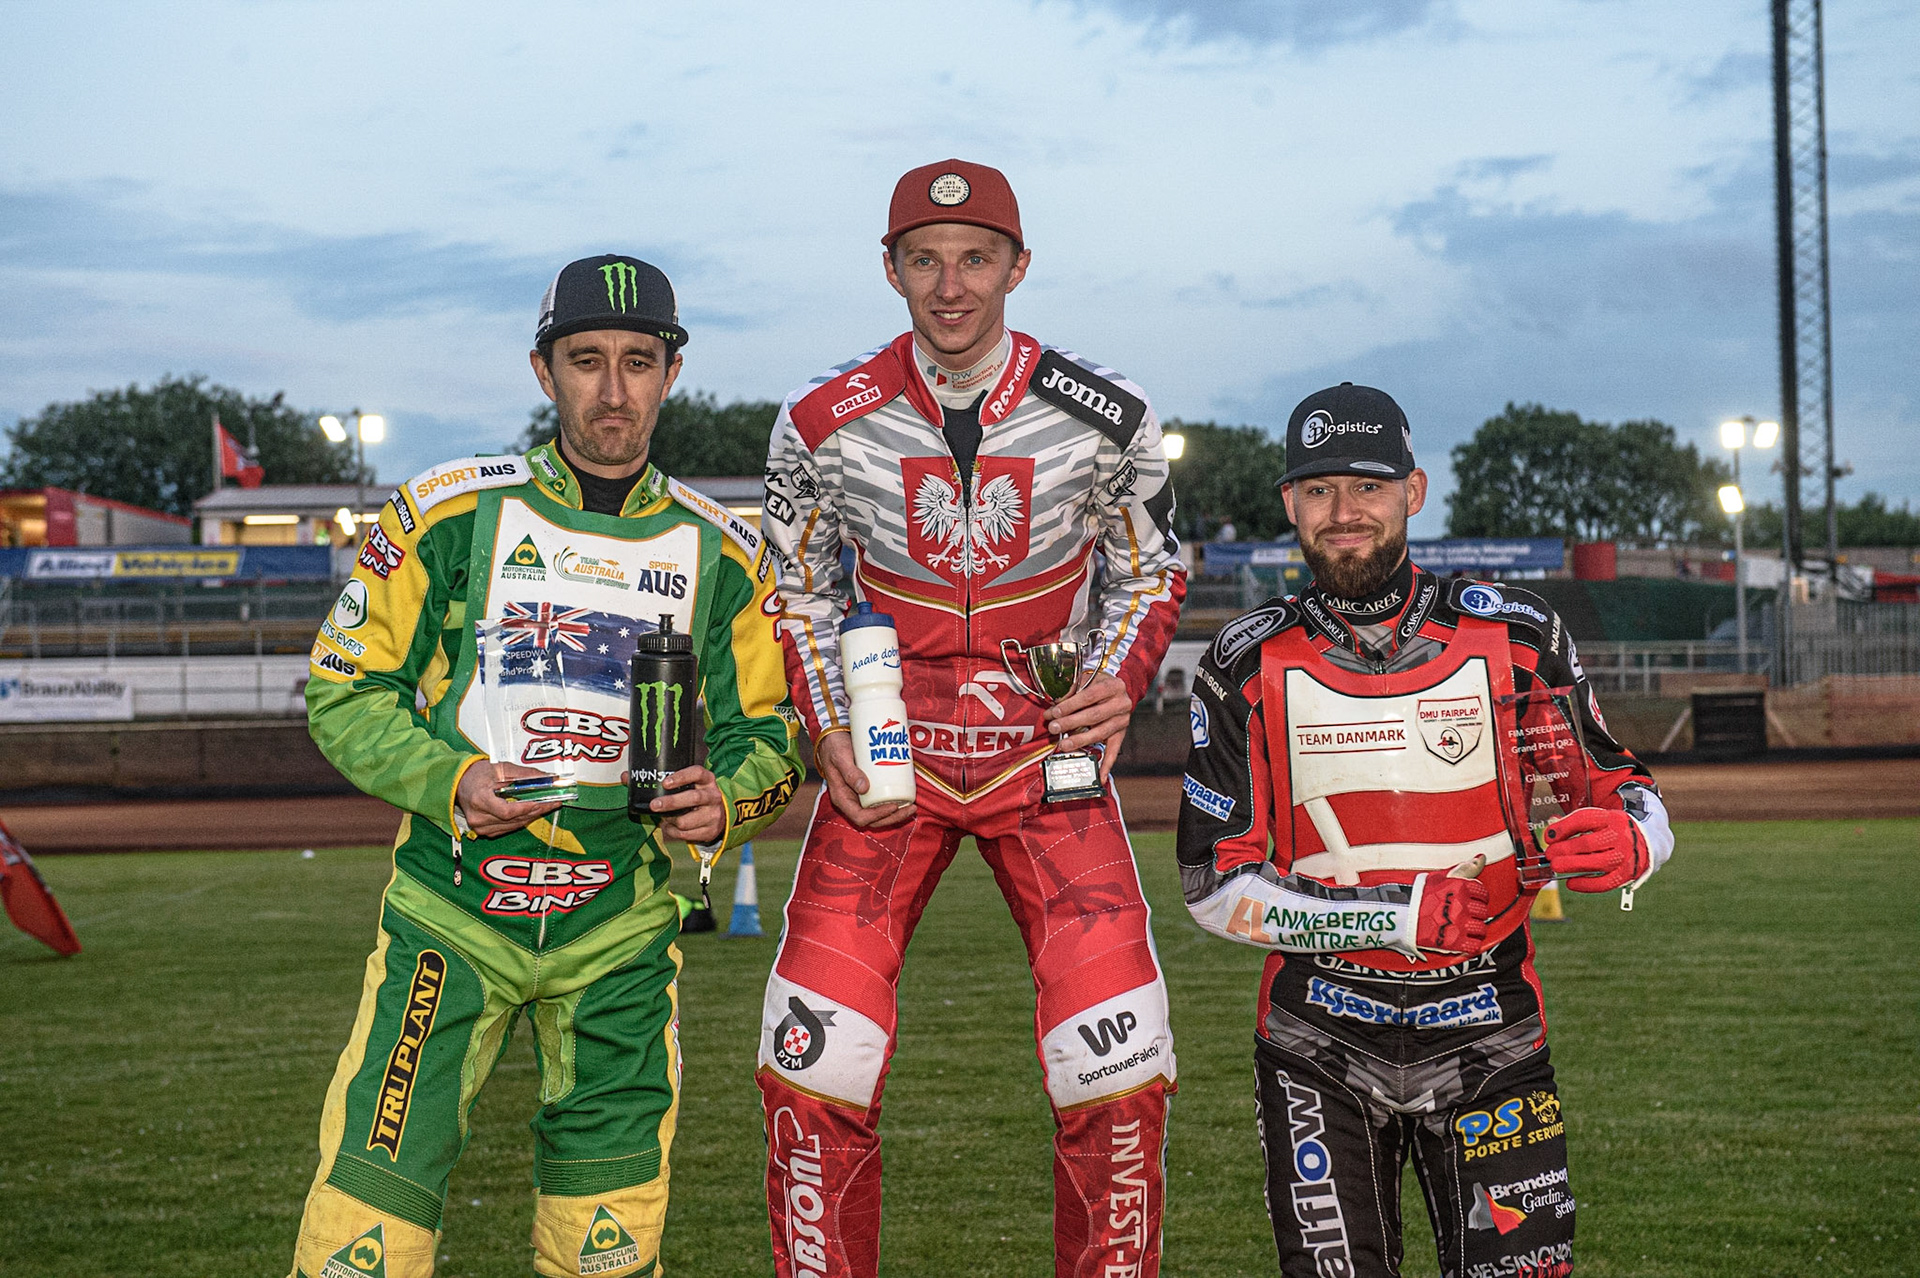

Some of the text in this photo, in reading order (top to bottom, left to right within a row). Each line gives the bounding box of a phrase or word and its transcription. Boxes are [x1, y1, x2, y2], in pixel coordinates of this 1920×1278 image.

[951, 370, 972, 380] DW
[835, 389, 879, 414] ORLEN
[1324, 420, 1379, 435] logistics
[502, 566, 546, 575] MOTORCYCLING
[580, 556, 600, 566] TEAM
[648, 560, 679, 572] SPORT
[501, 572, 546, 582] AUSTRALIA
[573, 563, 625, 580] AUSTRALIA
[637, 568, 688, 600] AUS
[340, 592, 360, 616] ATPI
[1490, 601, 1548, 623] logistics
[1222, 614, 1272, 653] GANTECH
[1420, 707, 1479, 719] DMU FAIRPLAY
[525, 710, 630, 744] CBS
[1297, 728, 1406, 746] TEAM DANMARK
[1508, 722, 1573, 738] FIM SPEEDWAY
[909, 724, 1025, 753] ORLEN
[1511, 738, 1574, 754] Grand Prix QR2
[526, 738, 621, 760] BINS
[870, 747, 910, 761] MAK
[1525, 771, 1570, 783] Glasgow
[485, 859, 610, 885] CBS
[487, 888, 600, 912] BINS
[1264, 906, 1396, 932] ANNEBERGS
[776, 1049, 803, 1069] PZM
[1077, 1044, 1159, 1086] SportoweFakty
[1456, 1097, 1524, 1146] PS
[1464, 1121, 1565, 1161] PORTE SERVICE
[580, 1245, 638, 1264] MOTORCYCLING
[580, 1253, 639, 1274] AUSTRALIA
